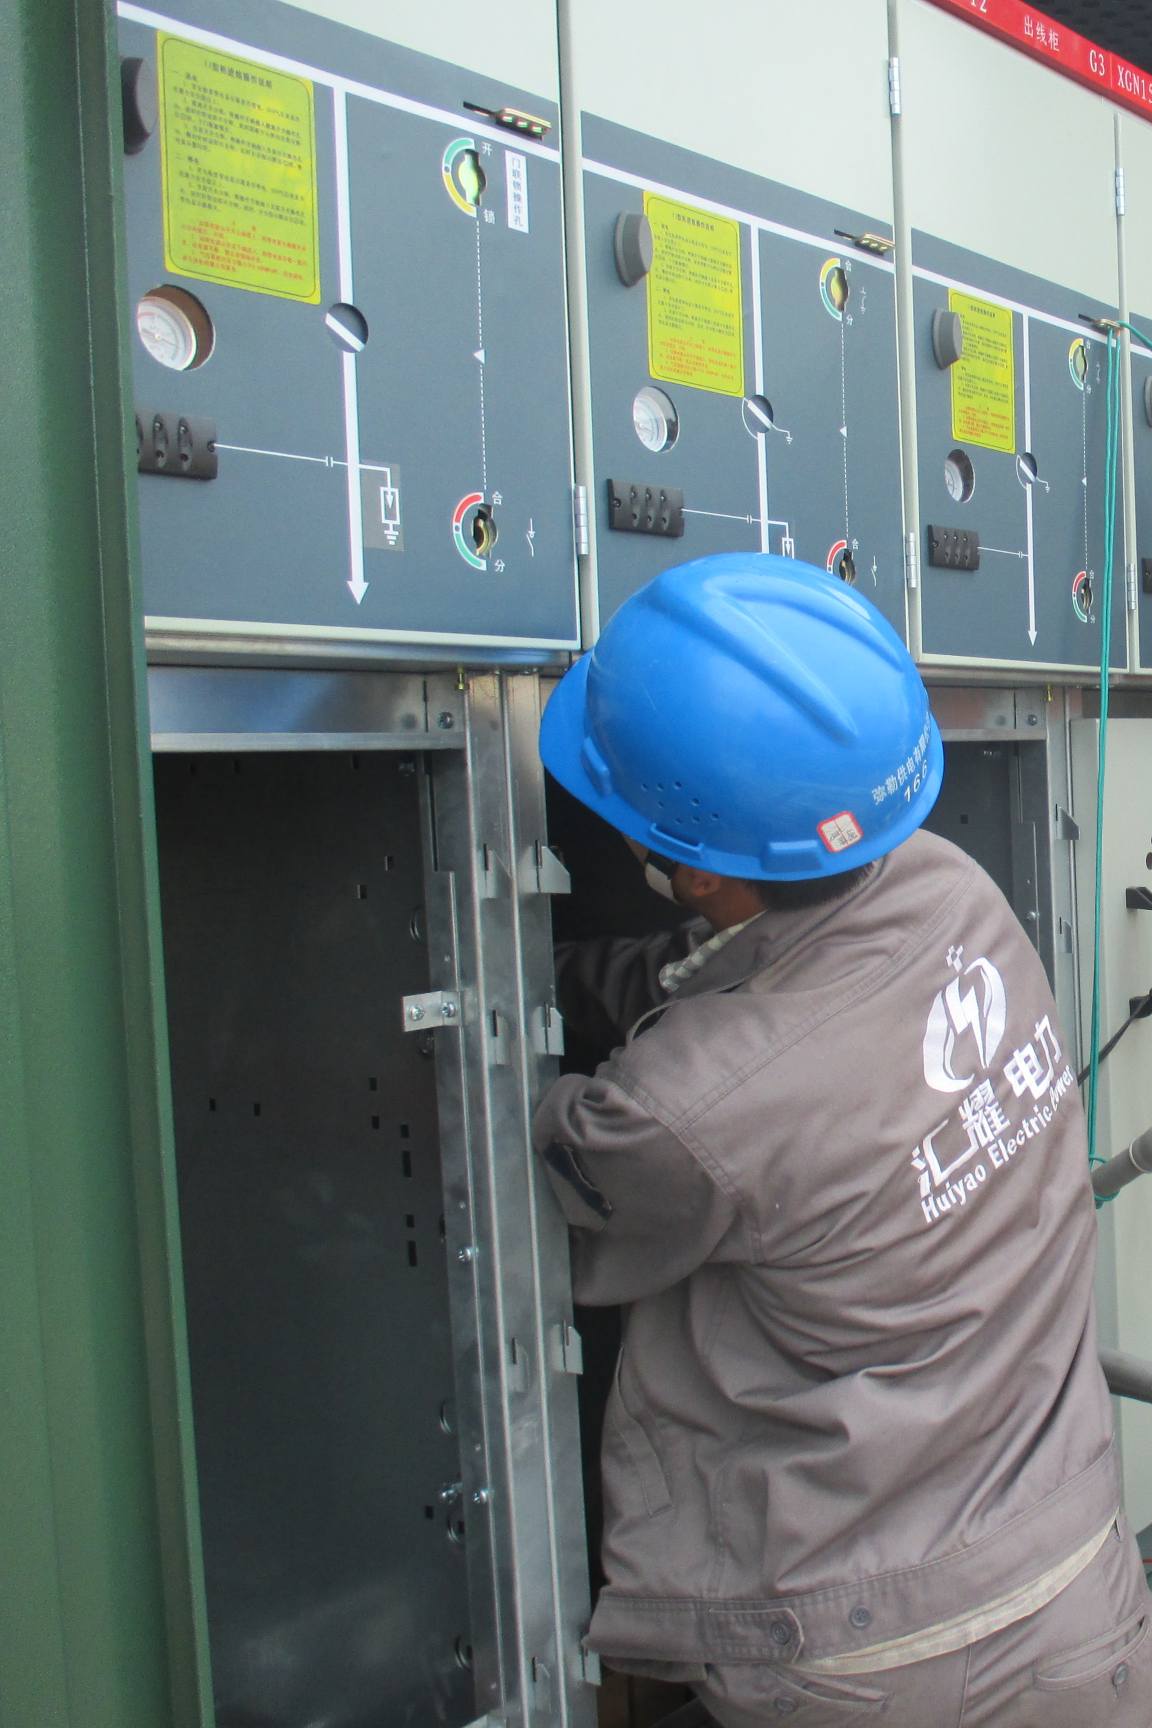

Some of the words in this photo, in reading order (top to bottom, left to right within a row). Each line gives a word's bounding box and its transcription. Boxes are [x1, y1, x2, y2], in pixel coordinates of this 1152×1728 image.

[1024, 16, 1060, 52] 出线柜
[1089, 50, 1105, 76] G3
[491, 491, 503, 505] 合
[494, 559, 506, 572] 分
[910, 1014, 1062, 1198] 汇耀电力
[920, 1163, 988, 1223] Huiyao
[988, 1104, 1054, 1170] Electric
